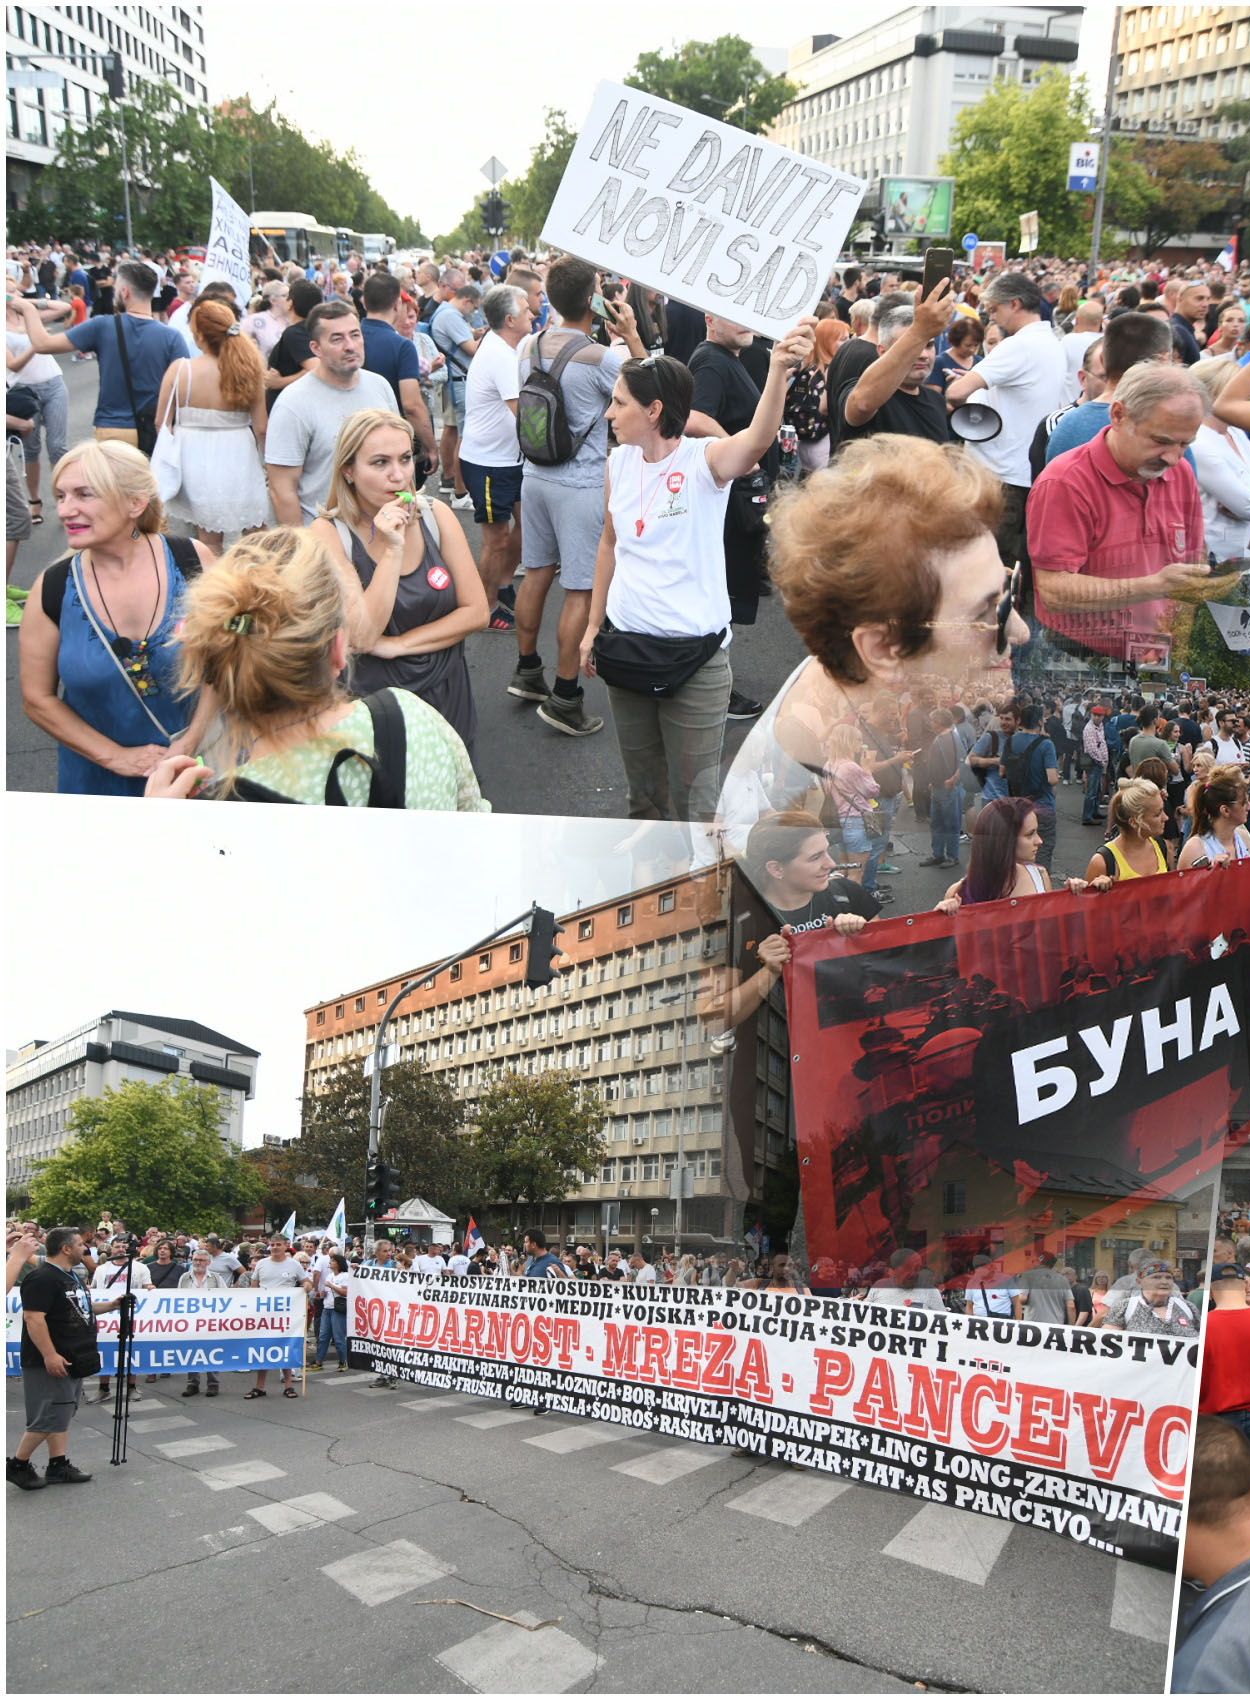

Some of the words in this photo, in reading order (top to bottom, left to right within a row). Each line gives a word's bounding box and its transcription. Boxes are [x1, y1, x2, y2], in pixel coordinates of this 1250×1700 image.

[589, 99, 683, 180] NE
[666, 129, 861, 252] DAVITE
[572, 175, 725, 286] NOVI
[706, 233, 819, 321] SAD
[1010, 983, 1242, 1126] БУНА
[153, 1296, 232, 1315] ЛЕВЧУ
[256, 1296, 291, 1313] НЕ!
[195, 1317, 291, 1333] РЕКОВАЦ!
[354, 1295, 580, 1371] SOLIDARNOST
[423, 1288, 547, 1312] GRAĐEVINARSTVO
[555, 1299, 613, 1320] MEDIJI
[622, 1304, 697, 1326] VOJSKA
[707, 1310, 816, 1342] POLICIJA
[831, 1326, 927, 1360] SPORT
[936, 1341, 949, 1363] I
[440, 1275, 512, 1293] PROSVETA
[518, 1279, 613, 1299] PRAVOSUĐE
[622, 1285, 714, 1306] KULTURA
[726, 1289, 949, 1336] POLJOPRIVREDA
[150, 1347, 224, 1367] LEVAC
[248, 1346, 290, 1364] NO!
[375, 1361, 399, 1378] BLOK
[415, 1368, 453, 1390] MAKIŠ
[455, 1375, 503, 1400] FRUŠKA
[505, 1386, 539, 1407] GORA
[544, 1392, 587, 1416] TESLA
[591, 1397, 653, 1430] ŠODROŠ
[659, 1412, 715, 1444] RAŠKA
[723, 1425, 768, 1455] NOVI
[771, 1438, 843, 1474] PAZAR
[851, 1457, 905, 1490] FIAT
[914, 1473, 948, 1502] AS
[433, 1354, 475, 1375] RAKITA
[480, 1362, 509, 1381] REVA
[513, 1366, 618, 1400] JADAR-LOZNICA
[622, 1384, 730, 1423] BOR-KRIVELJ
[737, 1403, 861, 1450] MAJDANPEK
[870, 1433, 928, 1468] LING
